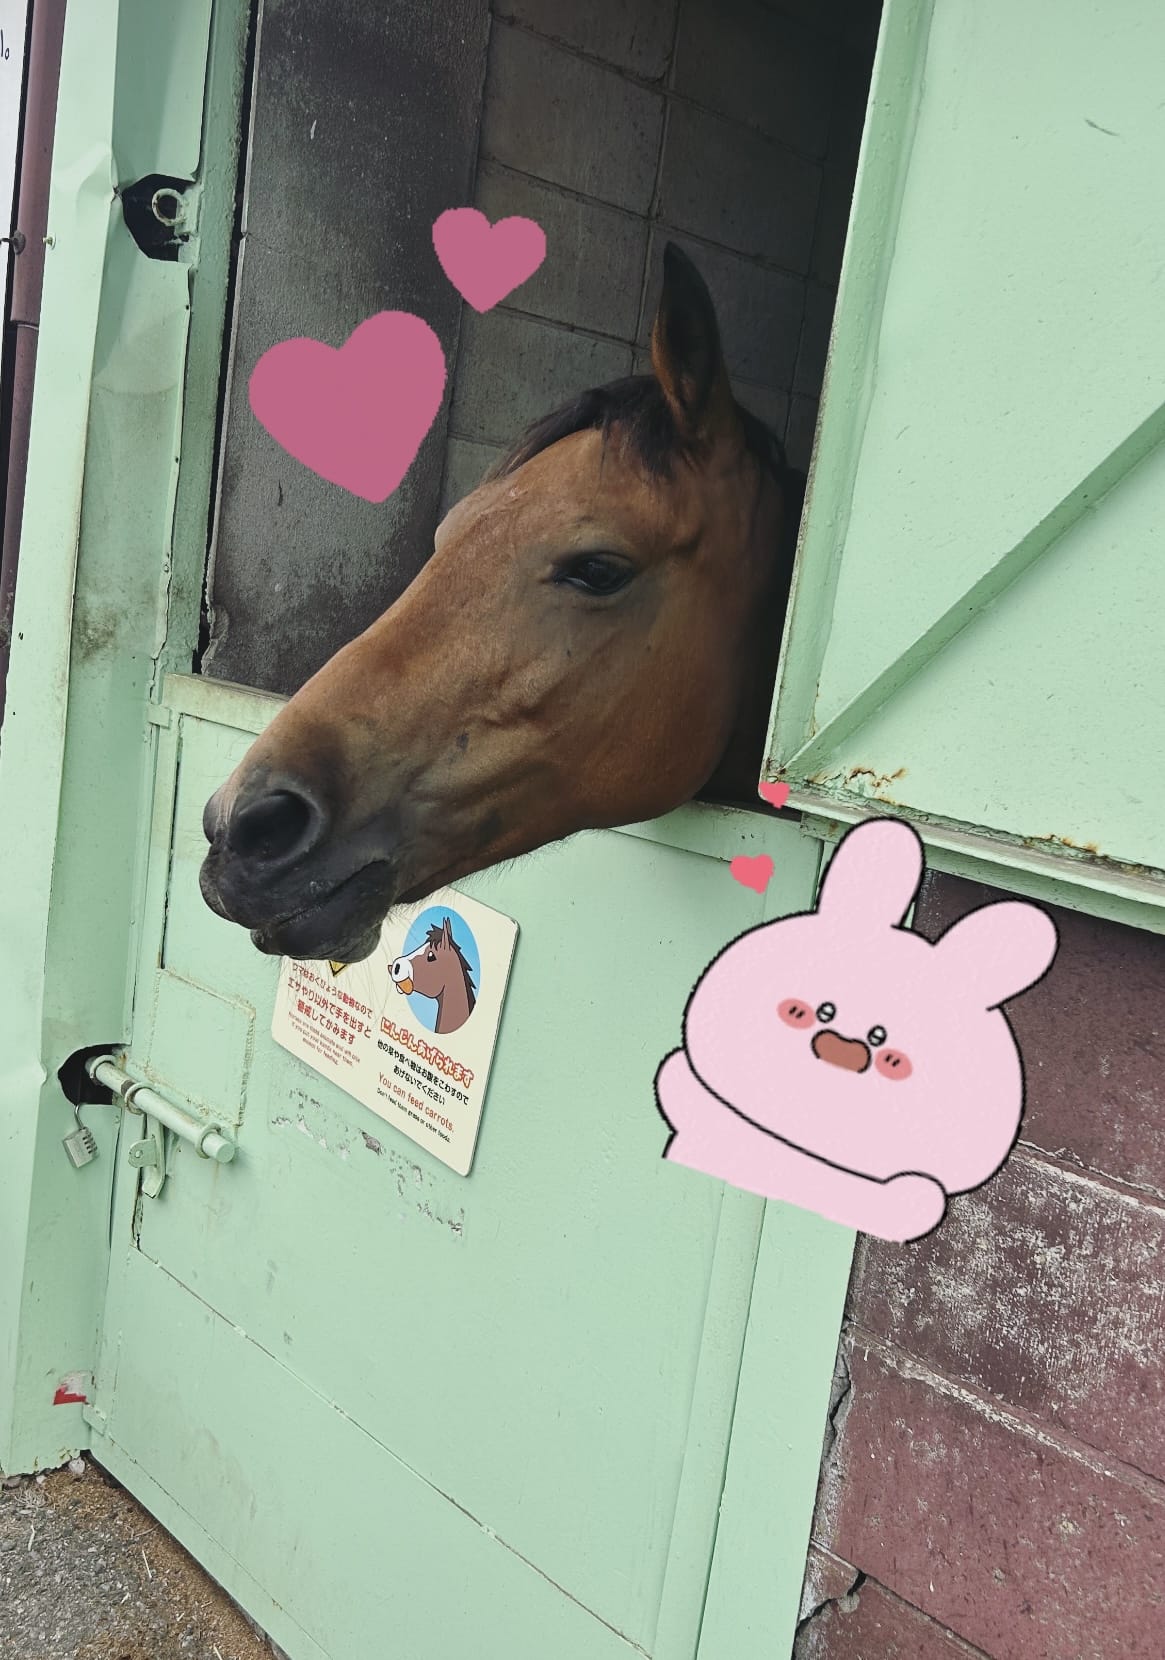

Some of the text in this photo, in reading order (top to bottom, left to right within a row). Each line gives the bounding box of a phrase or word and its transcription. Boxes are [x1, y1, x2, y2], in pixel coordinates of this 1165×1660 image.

[381, 1017, 474, 1089] にんじんあげられます
[379, 1072, 454, 1134] You can feed carrots.
[393, 1065, 445, 1106] あげないでください
